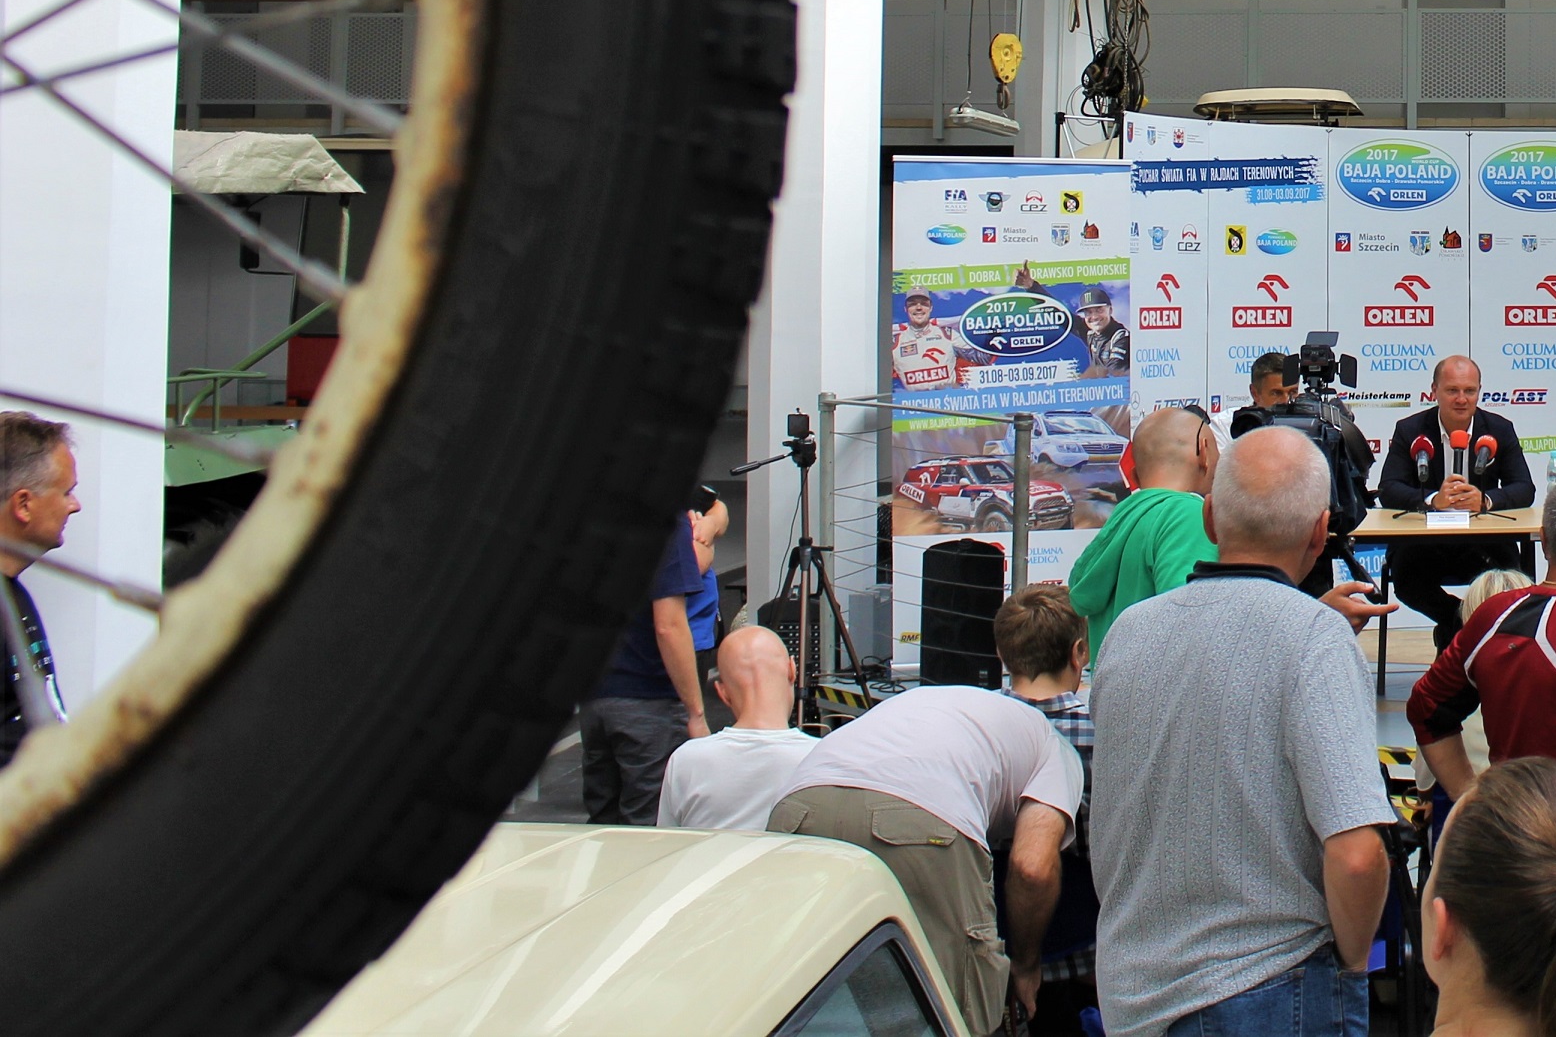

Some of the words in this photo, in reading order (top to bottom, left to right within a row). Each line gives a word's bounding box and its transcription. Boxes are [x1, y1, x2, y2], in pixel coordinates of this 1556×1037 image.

[1366, 149, 1398, 161] 2017
[1510, 151, 1544, 162] 2017
[1138, 167, 1159, 183] PUCHAR
[1161, 165, 1183, 182] ŚWIATA
[1187, 167, 1197, 182] FIA
[1200, 167, 1207, 181] W
[1211, 167, 1239, 181] RAJDACH
[1242, 165, 1294, 180] TERENOWYCH
[1343, 163, 1381, 178] BAJA
[1386, 164, 1451, 178] POLAND
[1487, 165, 1524, 179] BAJA
[1392, 191, 1424, 200] ORLEN
[1003, 227, 1027, 235] Miasto
[1358, 233, 1386, 241] Miasto
[1003, 235, 1038, 244] Szczecin
[1272, 239, 1298, 247] POLAND
[1358, 242, 1399, 252] Szczecin
[910, 271, 954, 287] SZCZECIN
[969, 269, 1001, 283] DOBRA
[1030, 264, 1074, 280] DRAWSKO
[1076, 262, 1128, 276] POMORSKIE
[986, 302, 1016, 314] 2017
[965, 315, 1002, 330] BAJA
[1006, 311, 1065, 328] POLAND
[1141, 309, 1179, 327] ORLEN
[1234, 309, 1288, 325] ORLEN
[1367, 309, 1430, 324] ORLEN
[1012, 336, 1043, 347] ORLEN
[1136, 347, 1181, 362] COLUMNA
[1361, 343, 1436, 357] COLUMNA
[1140, 364, 1176, 379] MEDICA
[1370, 358, 1428, 371] MEDICA
[907, 367, 948, 383] ORLEN
[979, 365, 1058, 384] 31.08-03.09.2017
[944, 394, 980, 411] ŚWIATA
[982, 393, 998, 409] FIA
[1000, 392, 1011, 407] W
[1012, 388, 1057, 407] RAJDACH
[1058, 384, 1124, 403] TERENOWYCH
[1348, 391, 1411, 403] Heisterkamp
[902, 484, 924, 502] ORLEN
[1028, 546, 1063, 556] OLUMNA
